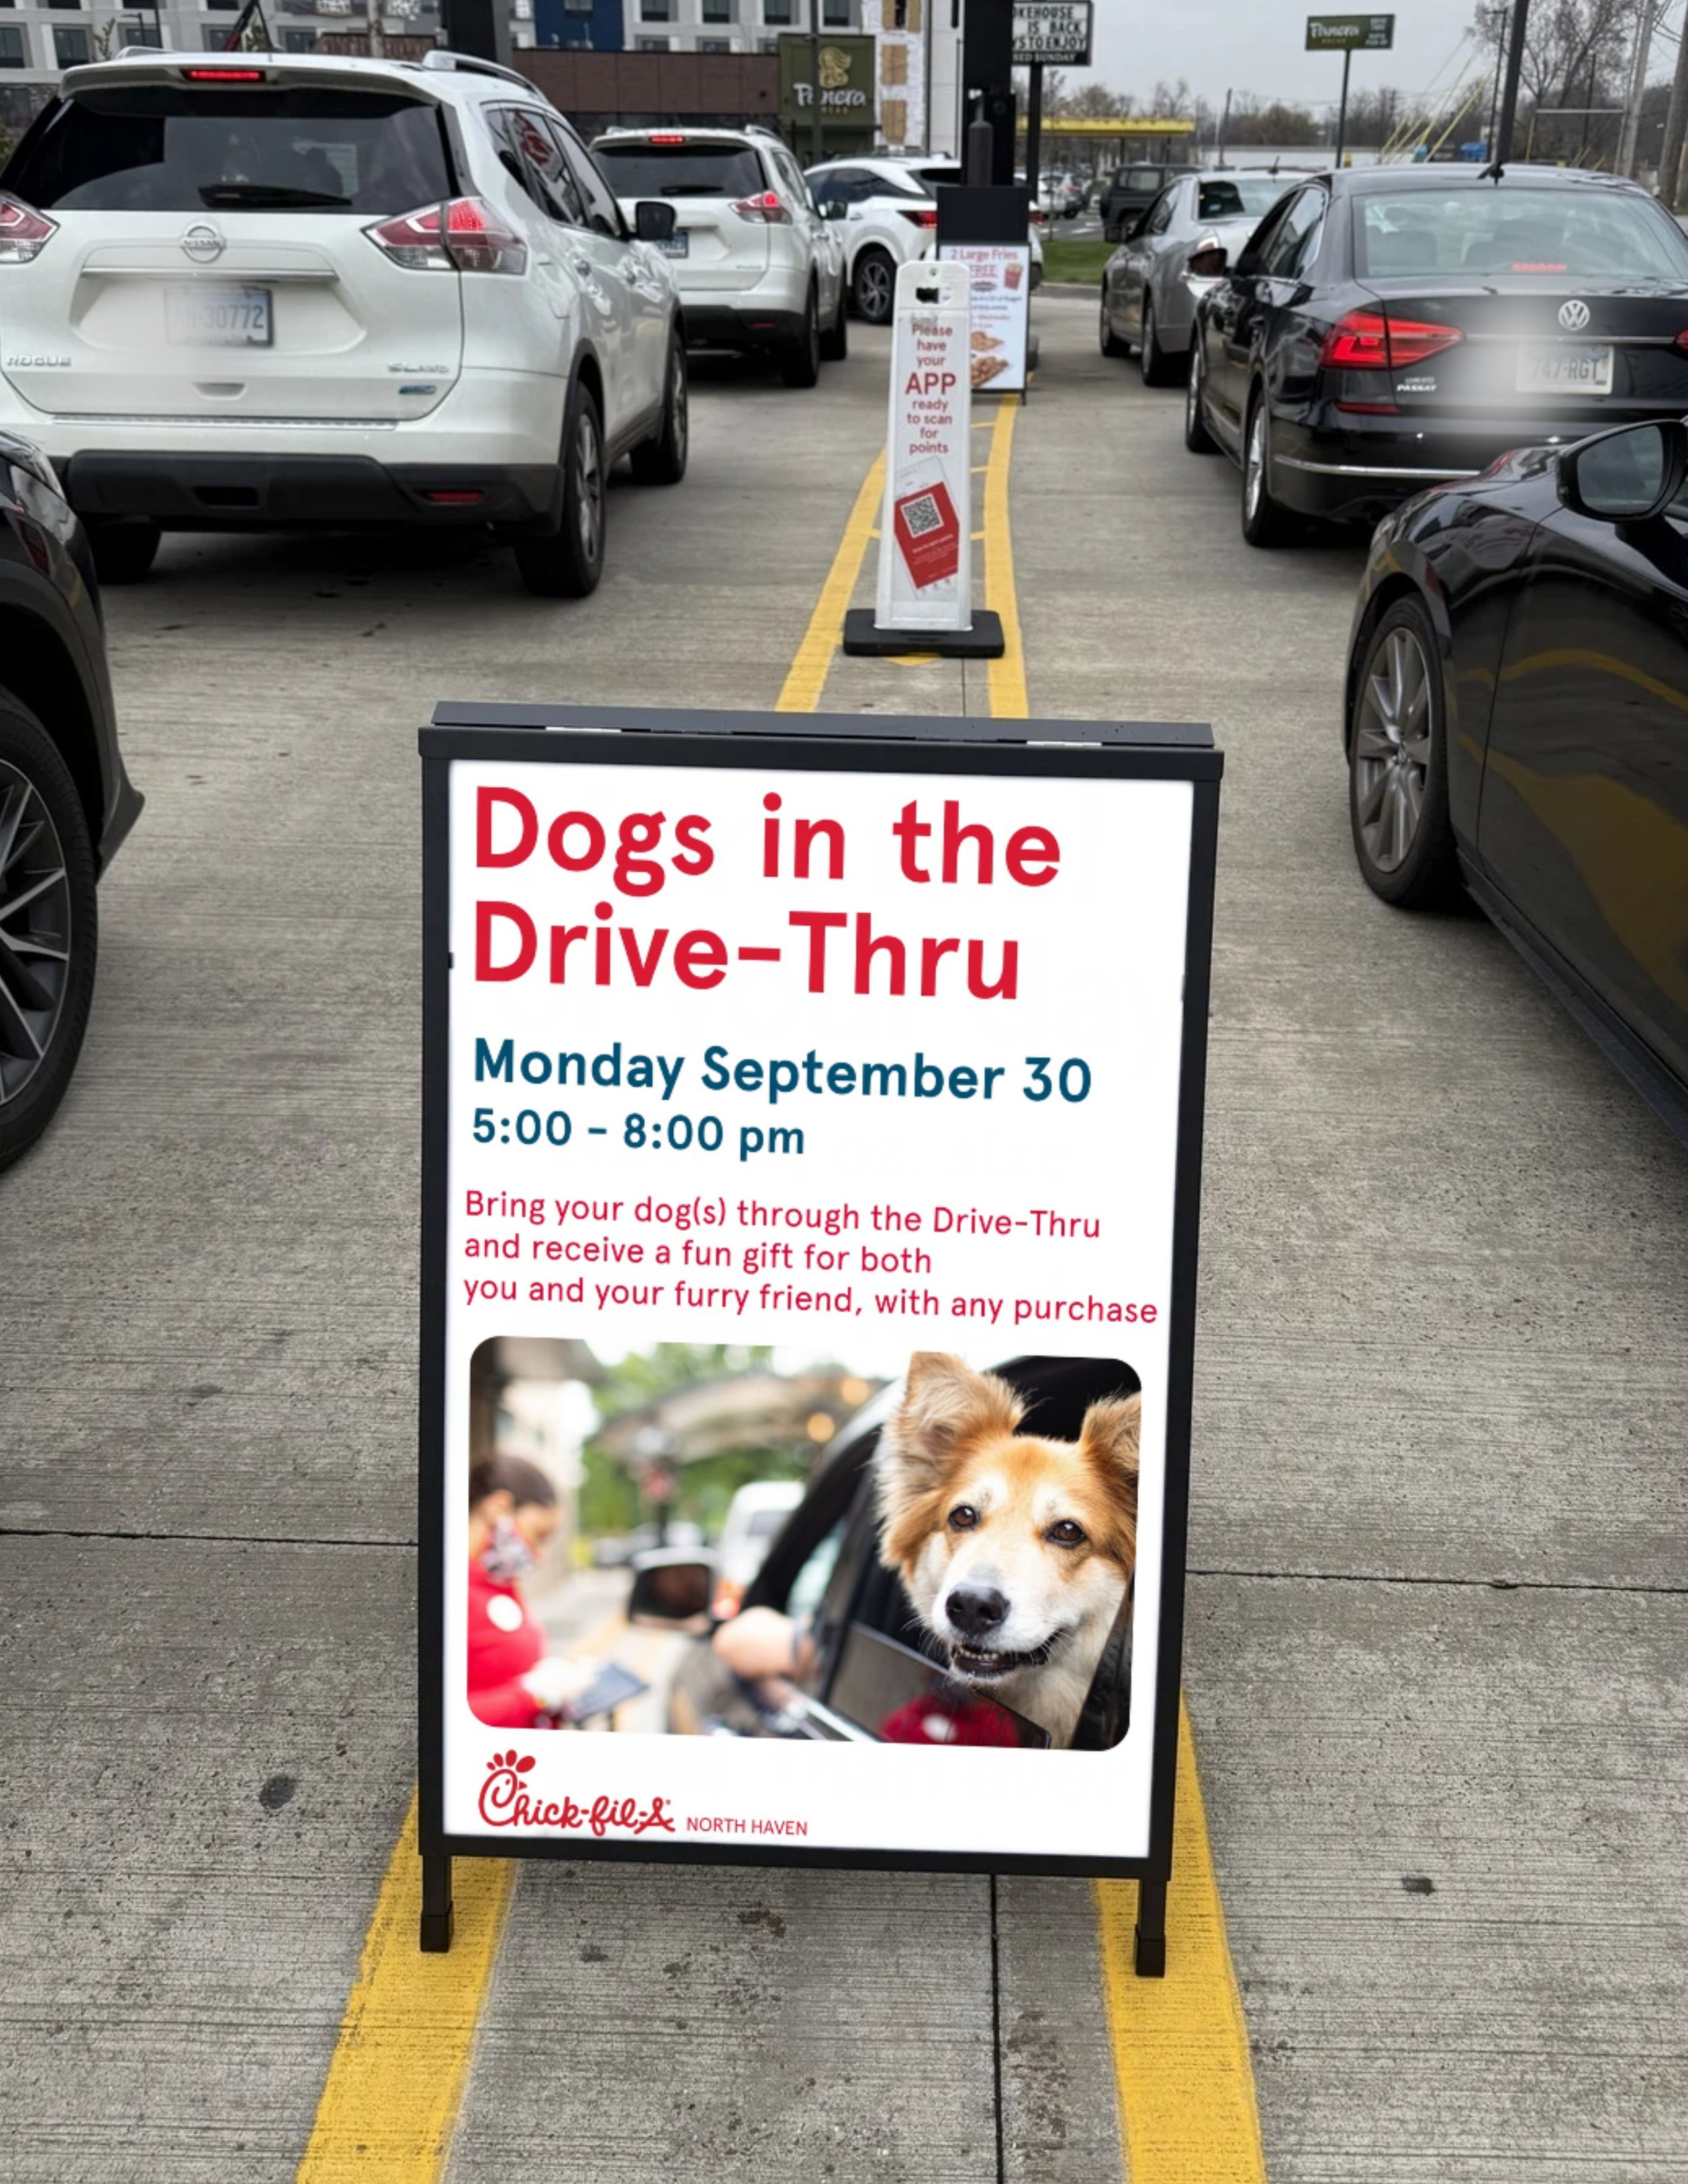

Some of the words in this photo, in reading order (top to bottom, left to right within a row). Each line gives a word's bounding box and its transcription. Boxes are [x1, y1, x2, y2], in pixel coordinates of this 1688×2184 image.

[1028, 21, 1039, 34] IS
[1050, 21, 1084, 35] BACK
[959, 248, 990, 262] Large
[912, 323, 953, 336] Please
[918, 339, 947, 351] have
[917, 355, 945, 367] your
[905, 372, 956, 395] APP
[912, 398, 949, 412] ready
[907, 412, 920, 424] to
[924, 414, 953, 425] scan
[920, 427, 938, 439] for
[909, 442, 949, 455] points
[476, 786, 714, 897] Dogs
[763, 792, 845, 880] in
[892, 800, 1060, 887] the
[475, 901, 1018, 999] Drive-Thru
[476, 1038, 683, 1100] Monday
[702, 1046, 1004, 1104] September
[1024, 1057, 1090, 1102] 30
[475, 1109, 571, 1145] 5:00
[625, 1113, 722, 1150] 8:00
[741, 1127, 803, 1161] pm
[467, 1190, 545, 1225] Bring
[556, 1200, 623, 1225] your
[635, 1196, 725, 1230] dog(s)
[737, 1200, 859, 1235] through
[872, 1204, 922, 1231] the
[934, 1206, 1099, 1238] Drive-Thru
[465, 1233, 519, 1258] and
[533, 1236, 644, 1263] receive
[656, 1245, 670, 1264] a
[683, 1240, 731, 1266] fun
[743, 1242, 793, 1274] gift
[805, 1244, 849, 1270] for
[862, 1246, 931, 1273] both
[465, 1280, 517, 1305] you
[529, 1277, 583, 1302] and
[596, 1285, 664, 1310] your
[675, 1281, 749, 1315] furry
[760, 1283, 862, 1315] friend,
[875, 1289, 939, 1315] with
[951, 1298, 1003, 1324] any
[1015, 1296, 1157, 1325] purchase
[687, 1817, 745, 1832] NORTH
[751, 1821, 808, 1836] HAVEN
